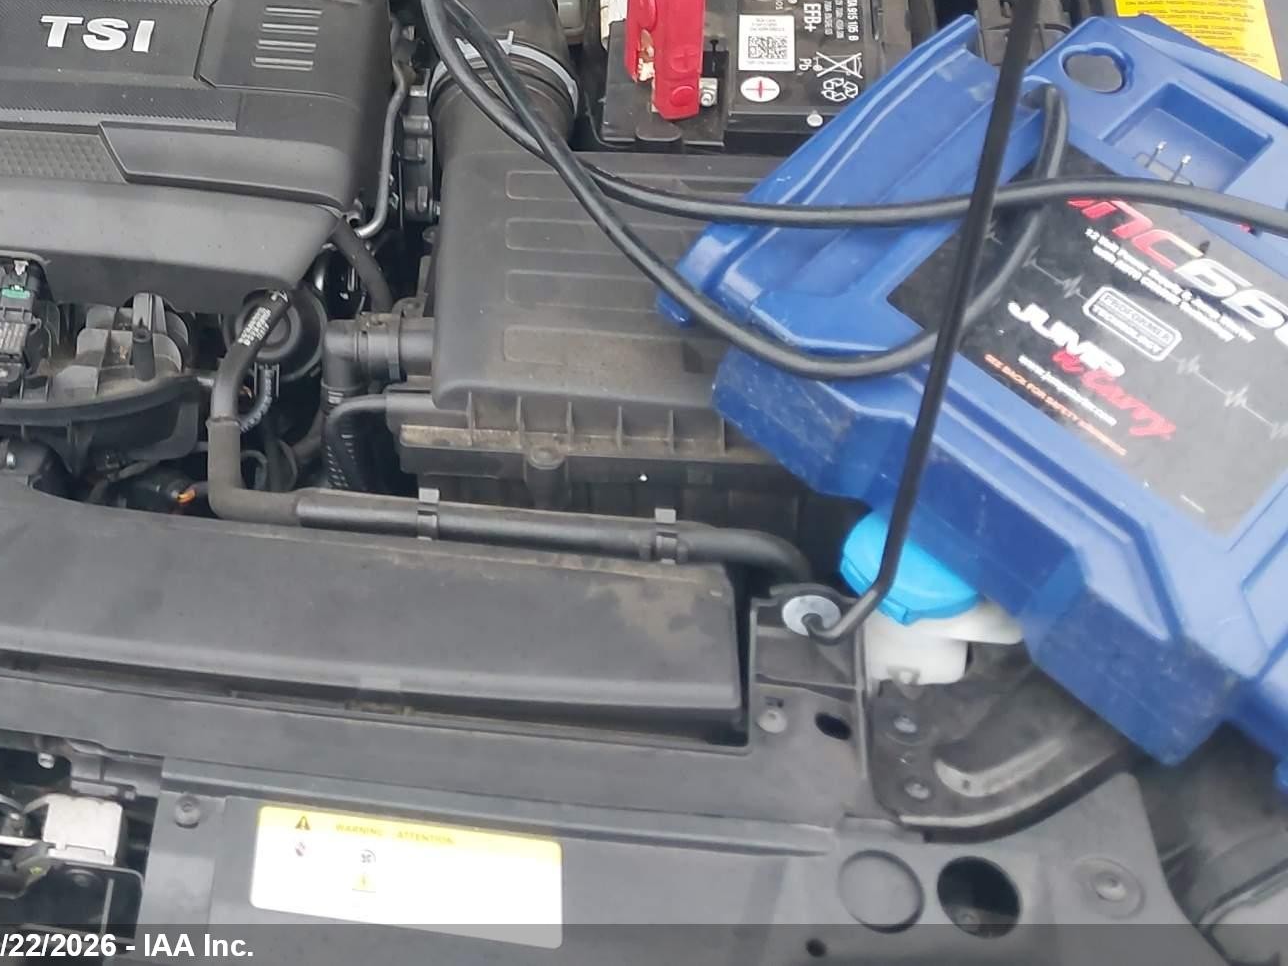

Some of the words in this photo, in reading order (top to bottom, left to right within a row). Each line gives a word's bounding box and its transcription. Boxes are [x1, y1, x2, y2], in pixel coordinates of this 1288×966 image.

[803, 2, 821, 33] EFB+
[847, 7, 859, 20] 915
[40, 15, 155, 53] TSI
[847, 21, 860, 33] 105
[799, 58, 812, 71] Pb
[1008, 302, 1125, 377] JUMP
